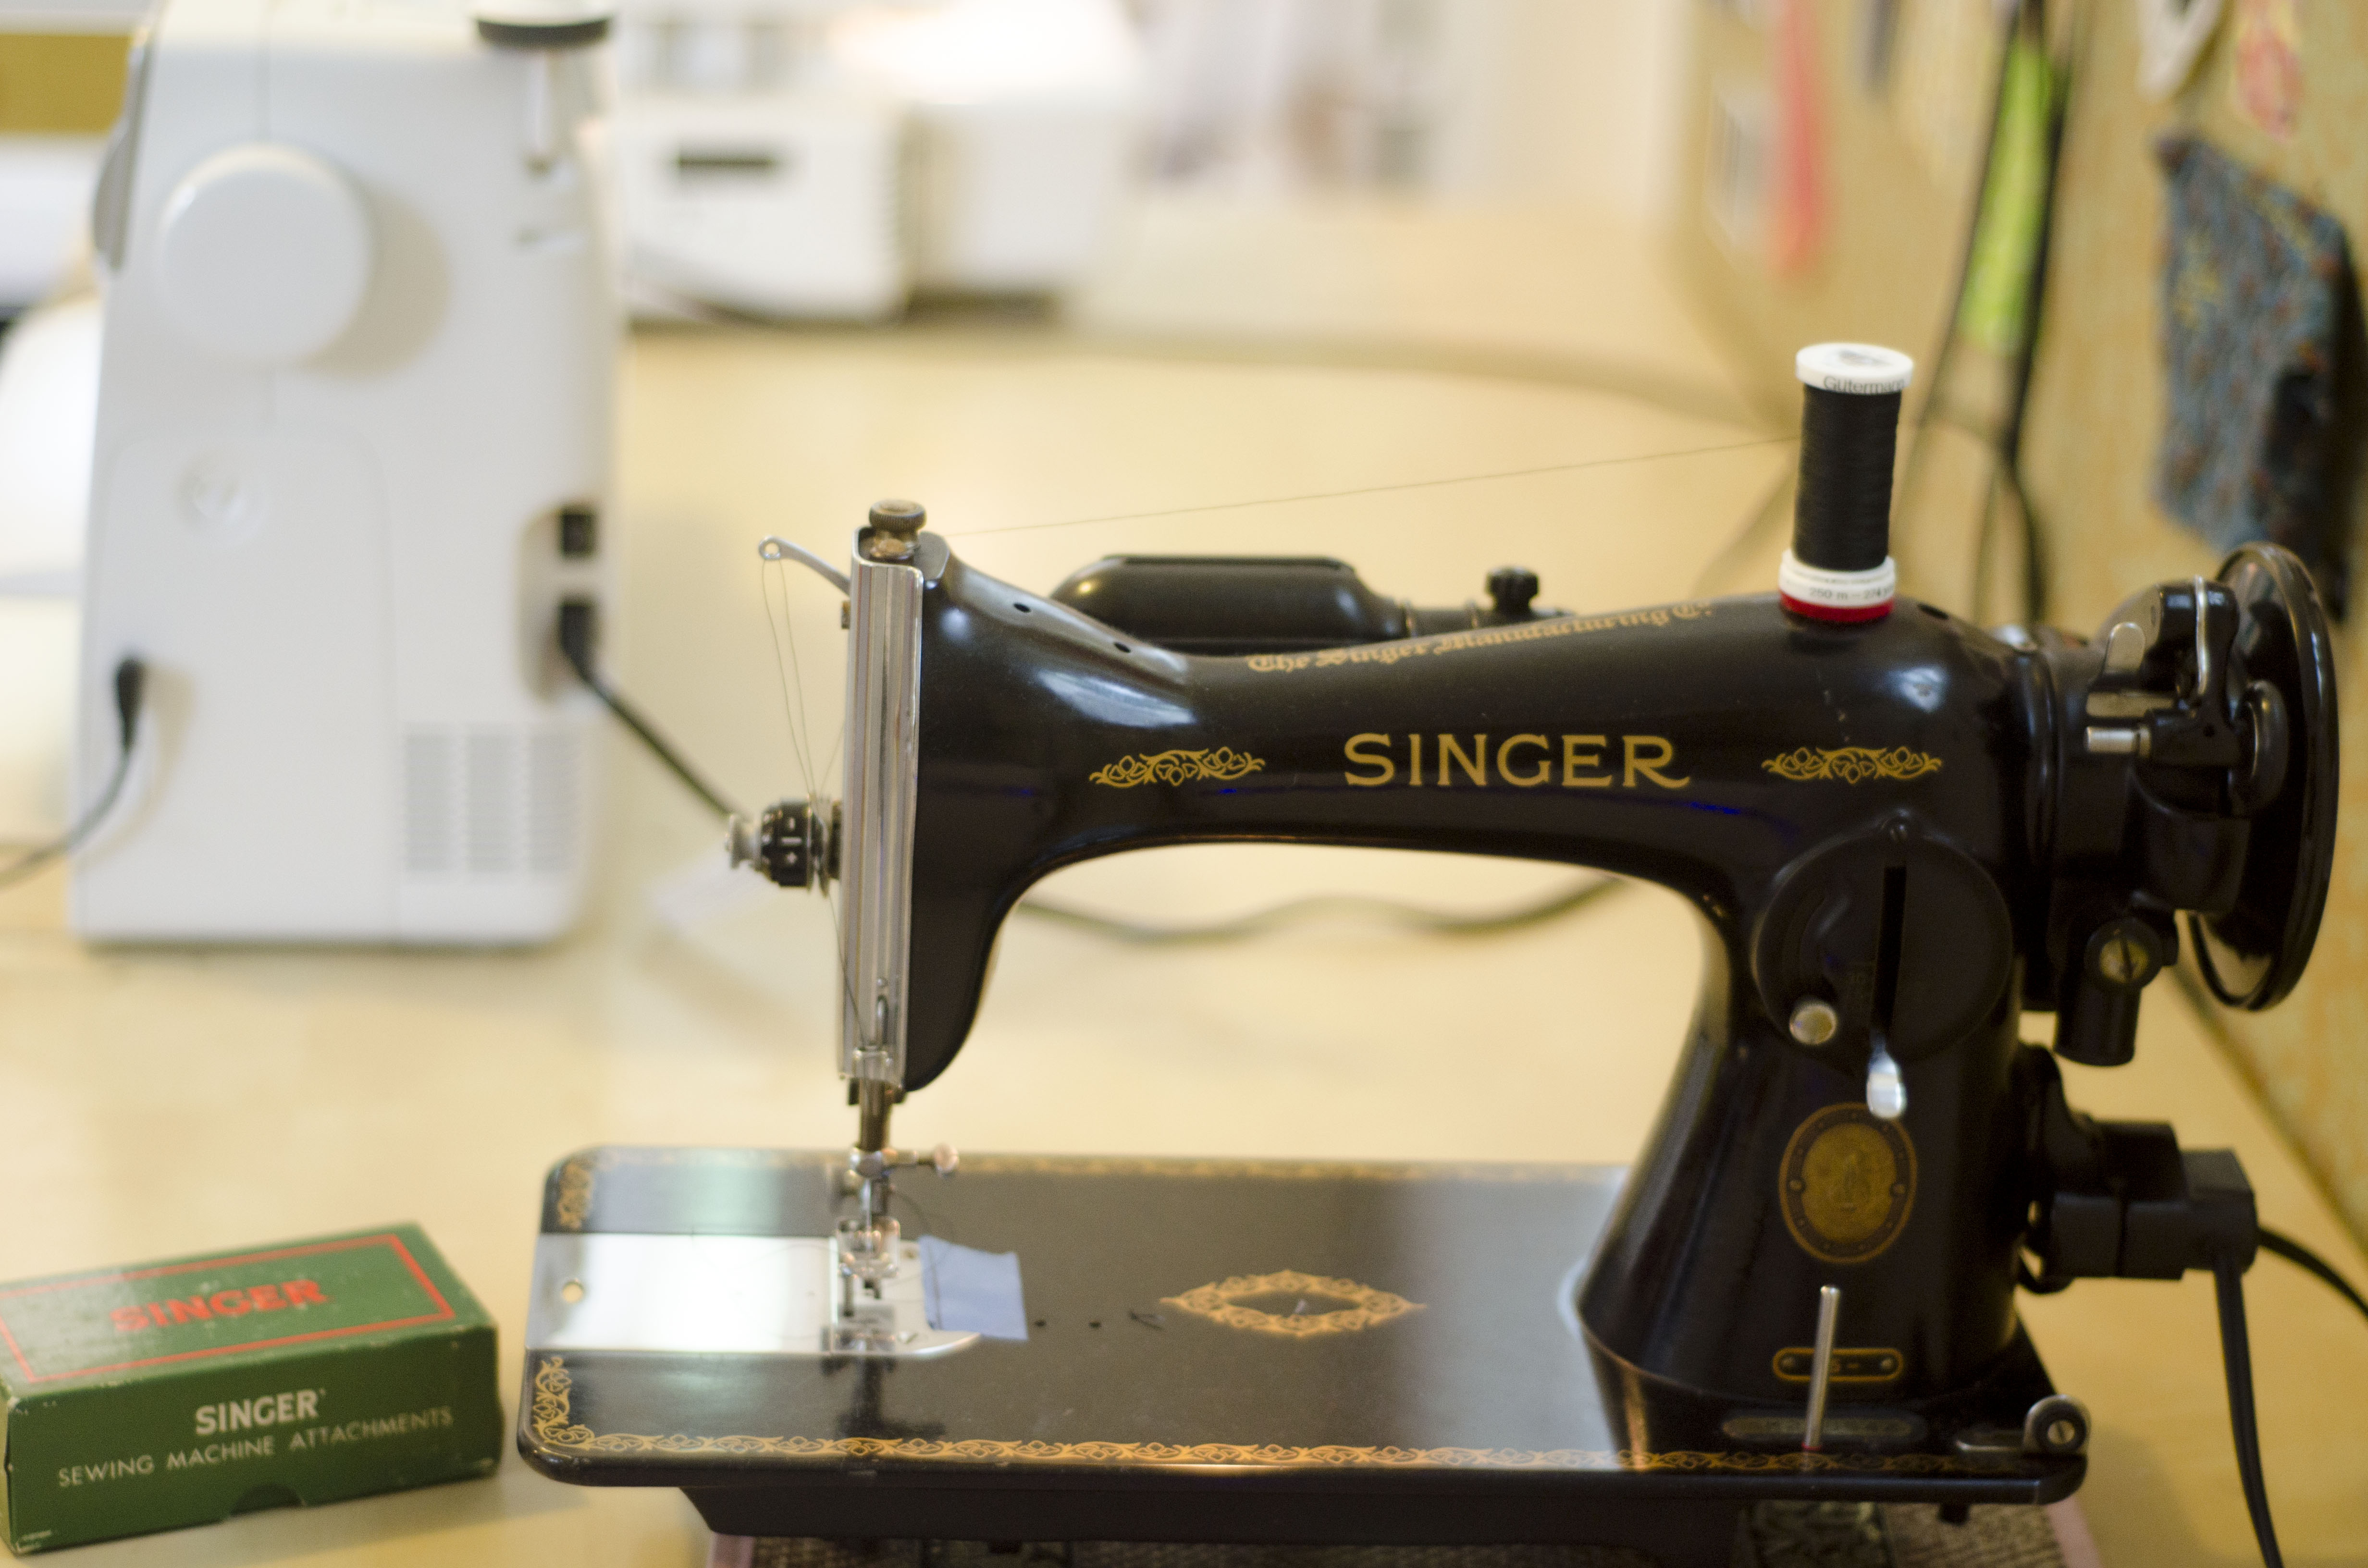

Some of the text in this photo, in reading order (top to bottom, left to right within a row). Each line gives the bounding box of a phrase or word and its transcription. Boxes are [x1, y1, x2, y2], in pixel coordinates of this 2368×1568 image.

[1246, 654, 1310, 673] The
[1316, 643, 1430, 665] Singer
[1432, 608, 1670, 655] Manufacturing
[1344, 733, 1690, 789] SINGER
[110, 1279, 327, 1332] SINGER
[195, 1389, 320, 1435] SINGER
[58, 1406, 454, 1488] SEWING MACHINE ATTACHMENTS
